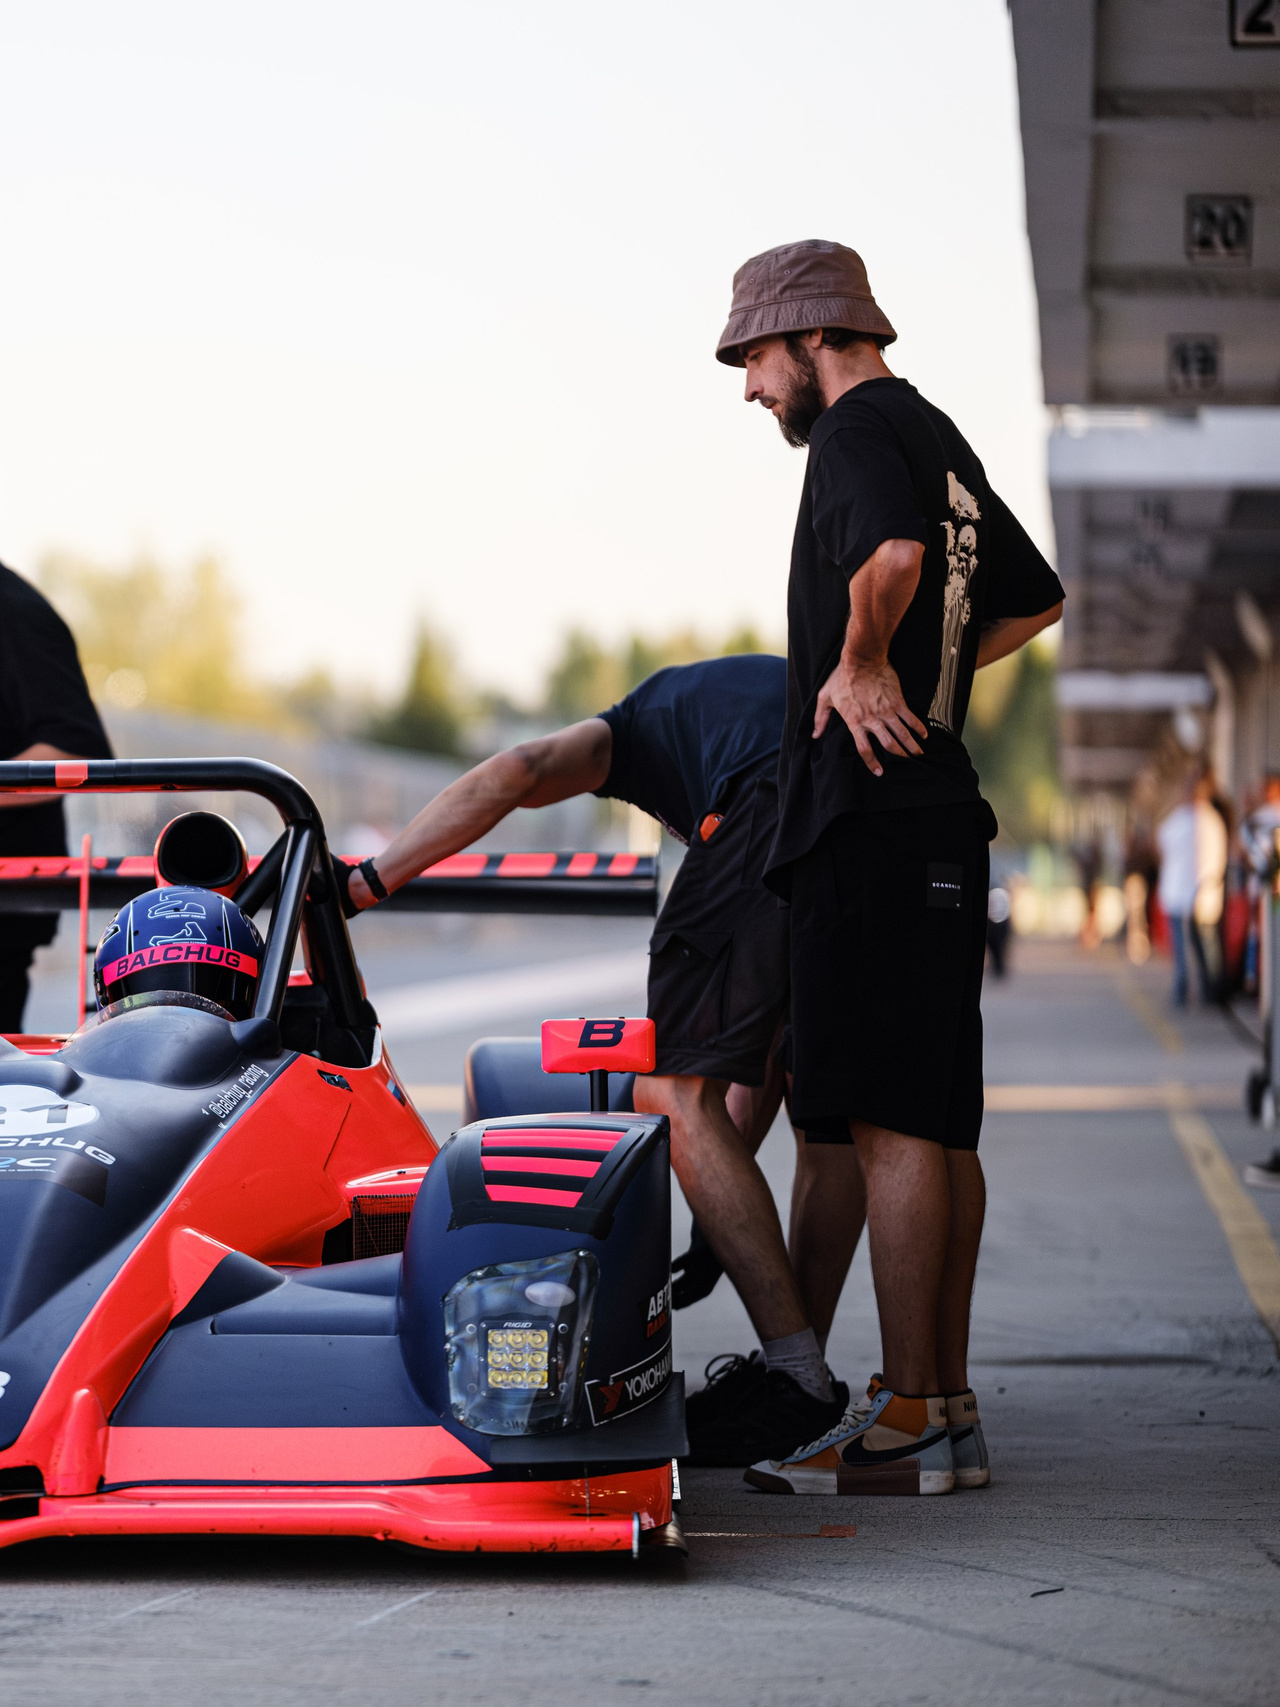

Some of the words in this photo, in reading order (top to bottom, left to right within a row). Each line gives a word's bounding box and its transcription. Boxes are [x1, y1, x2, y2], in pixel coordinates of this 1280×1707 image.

[1193, 205, 1247, 249] 20
[116, 945, 241, 977] BALCHUG
[578, 1019, 626, 1048] B
[208, 1063, 269, 1118] @balchug_racing
[625, 1347, 671, 1401] YOKOHAM
